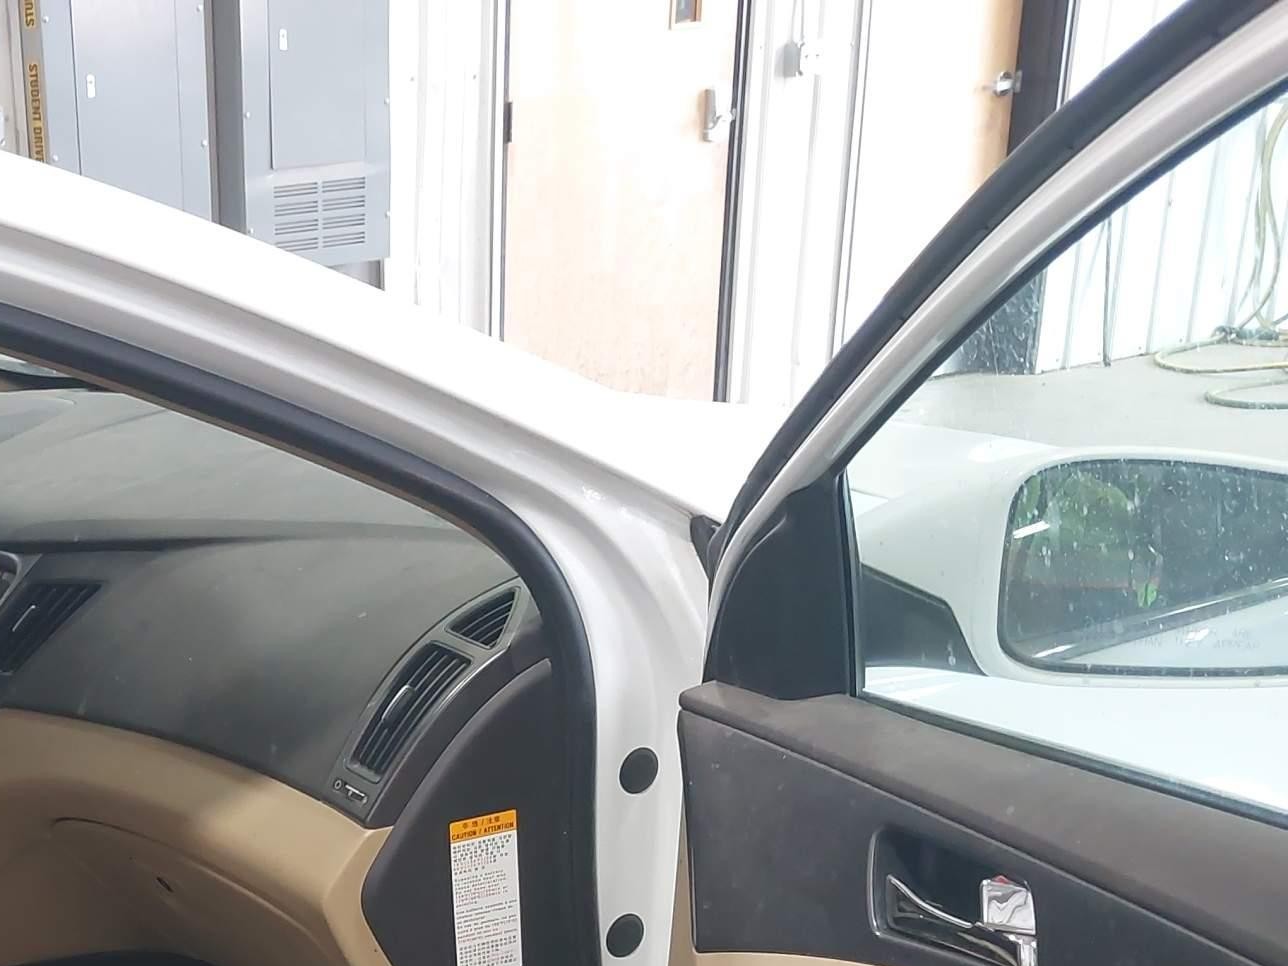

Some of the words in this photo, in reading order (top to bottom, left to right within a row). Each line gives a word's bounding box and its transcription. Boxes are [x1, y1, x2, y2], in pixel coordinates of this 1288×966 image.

[29, 63, 42, 121] STUDENT
[451, 829, 478, 841] CAUTION
[483, 821, 514, 834] ATTENTION
